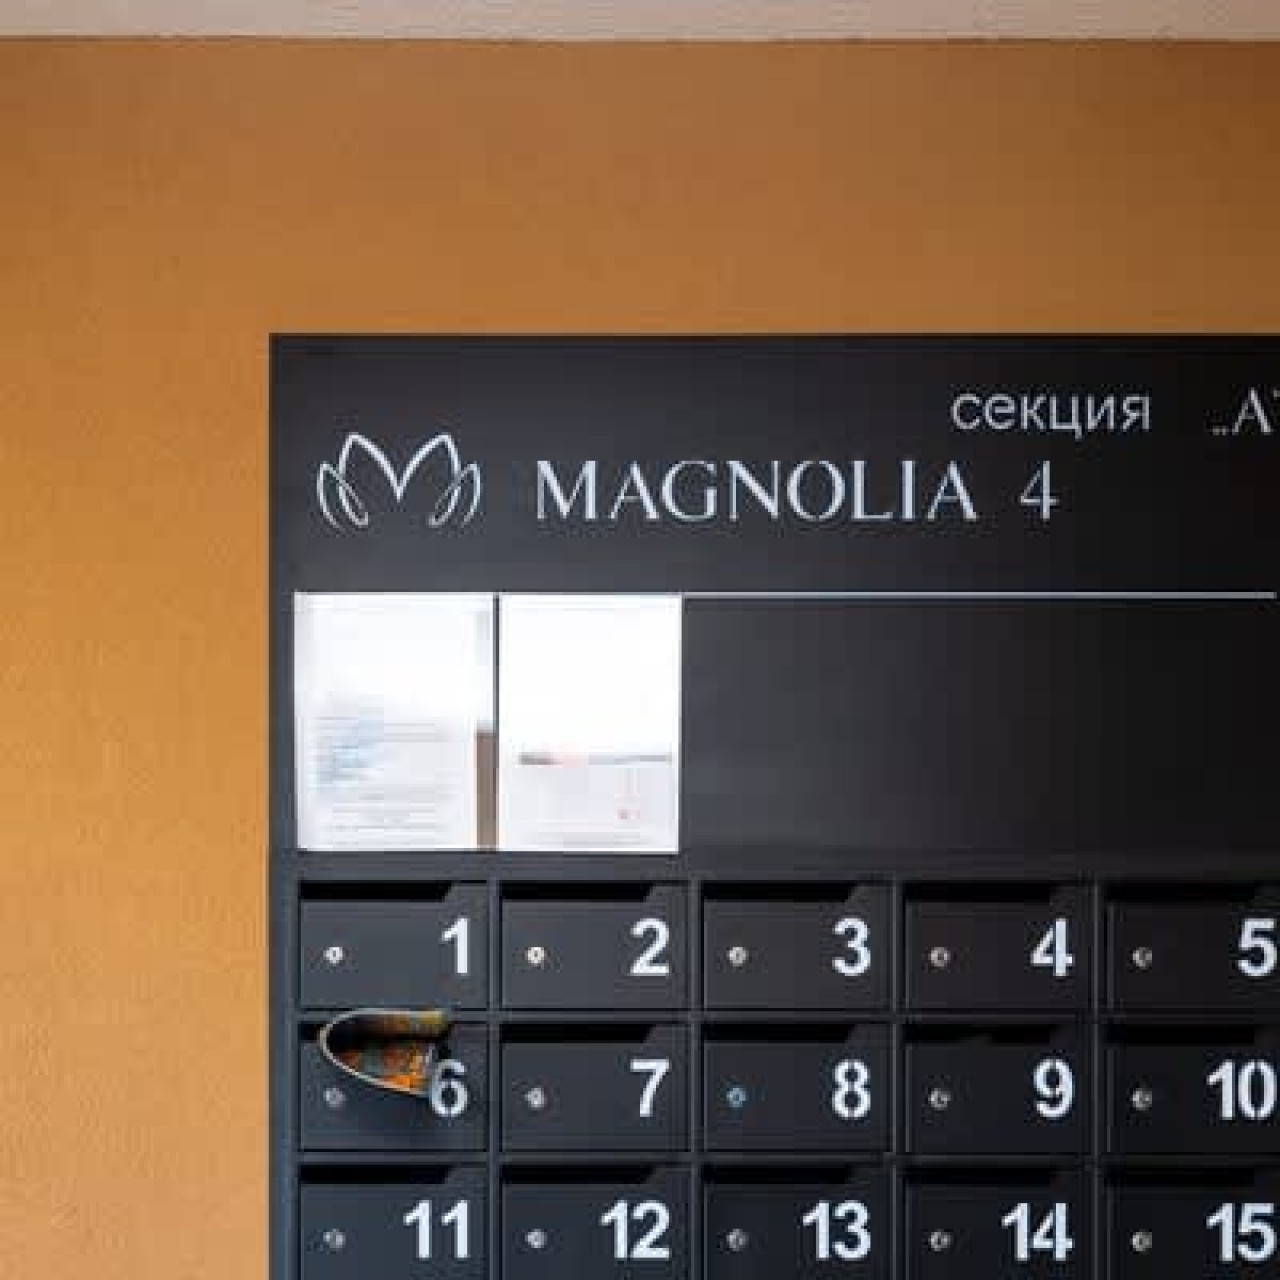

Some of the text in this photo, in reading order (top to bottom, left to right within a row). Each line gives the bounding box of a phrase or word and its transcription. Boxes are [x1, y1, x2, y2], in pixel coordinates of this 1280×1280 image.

[951, 391, 1151, 440] секция
[536, 459, 1058, 523] MAGNOLIA 4
[440, 917, 469, 975] 1
[629, 917, 670, 977] 2
[832, 917, 871, 977] 3
[1031, 918, 1073, 977] 4
[1236, 918, 1278, 977] 5
[429, 1059, 469, 1118] 6
[629, 1058, 670, 1118] 7
[831, 1059, 871, 1119] 8
[1032, 1058, 1073, 1119] 9
[1206, 1060, 1278, 1119] 10
[402, 1199, 469, 1260] 11
[600, 1199, 670, 1260] 12
[802, 1199, 871, 1261] 13
[1000, 1202, 1073, 1262] 14
[1206, 1202, 1277, 1262] 15
